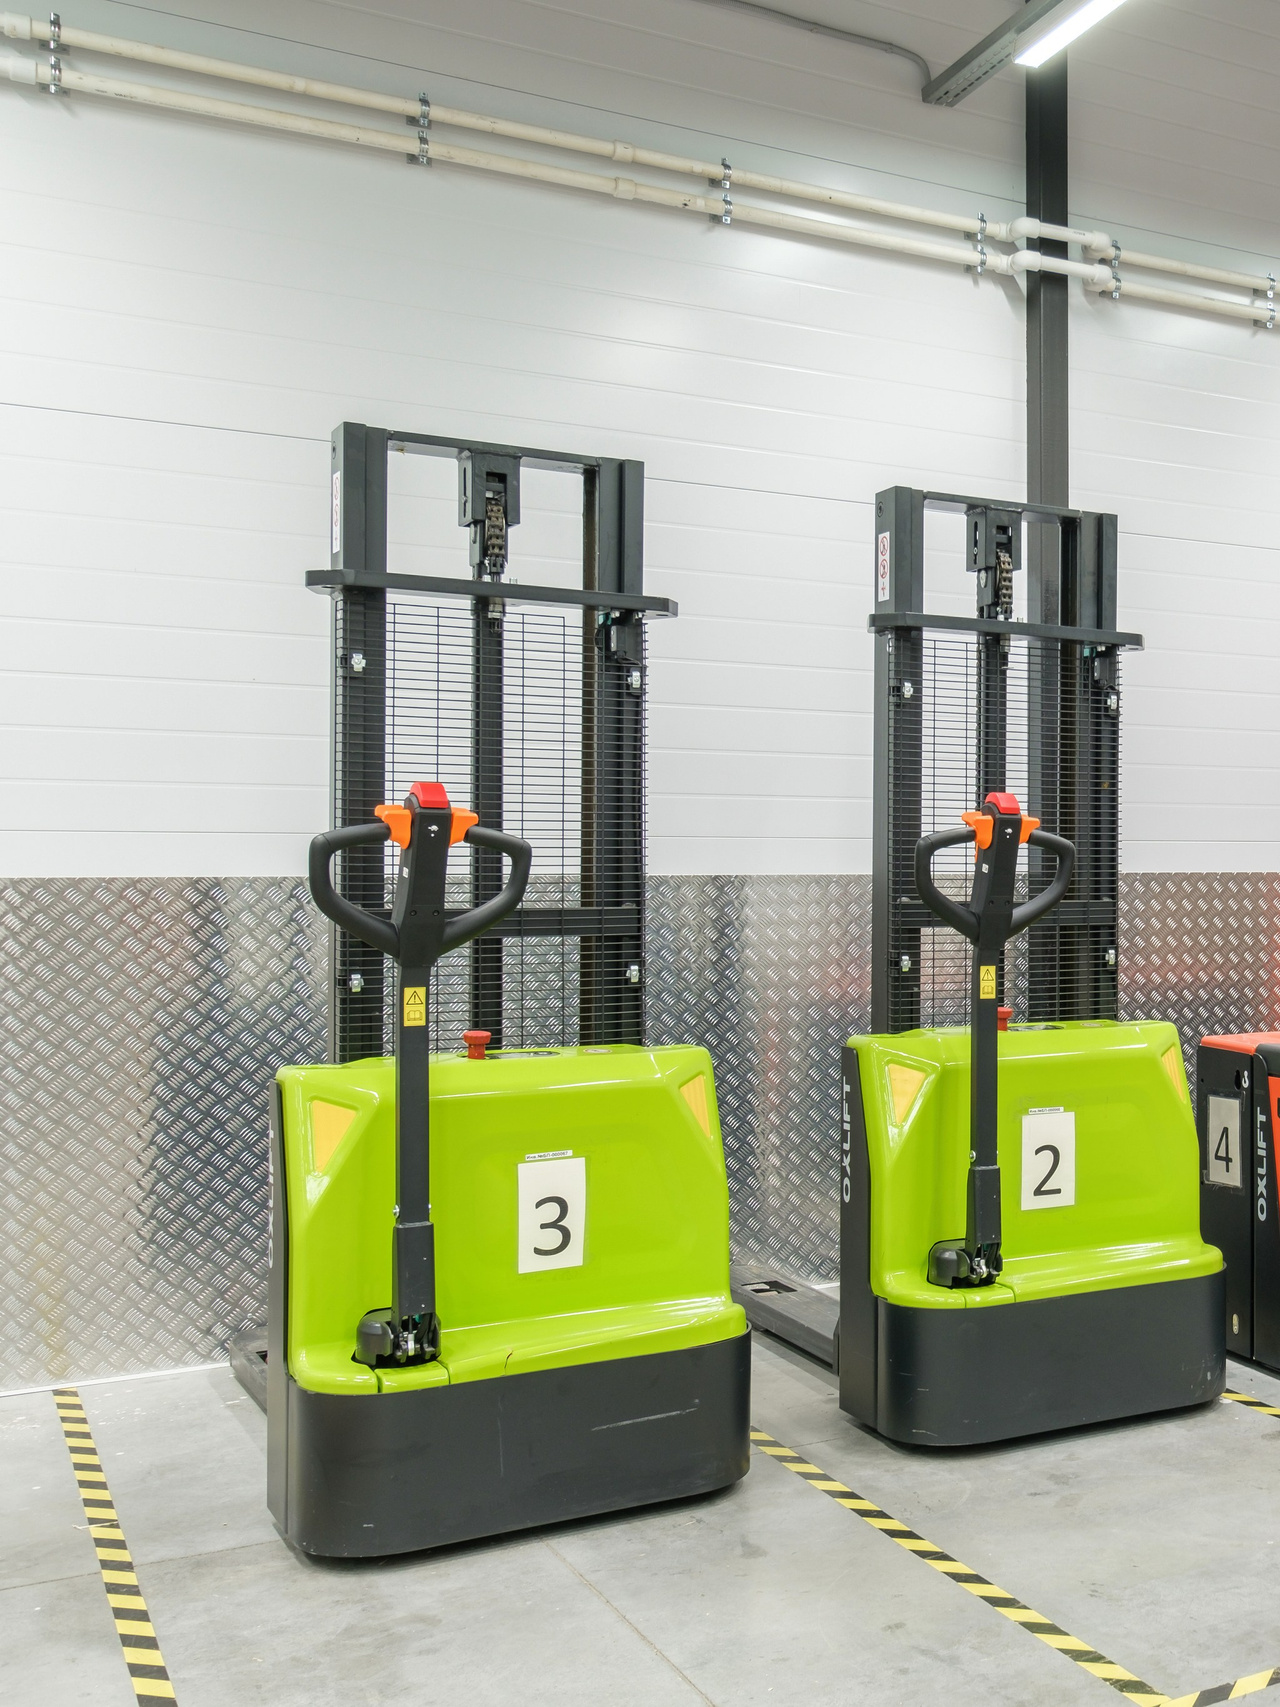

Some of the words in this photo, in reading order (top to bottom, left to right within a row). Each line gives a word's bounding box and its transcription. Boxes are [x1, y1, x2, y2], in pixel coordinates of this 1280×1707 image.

[842, 1075, 852, 1204] OXLIFT
[1033, 1144, 1062, 1197] 2
[1214, 1126, 1233, 1173] 4
[1257, 1106, 1267, 1222] OXLIFT
[533, 1195, 572, 1257] 3
